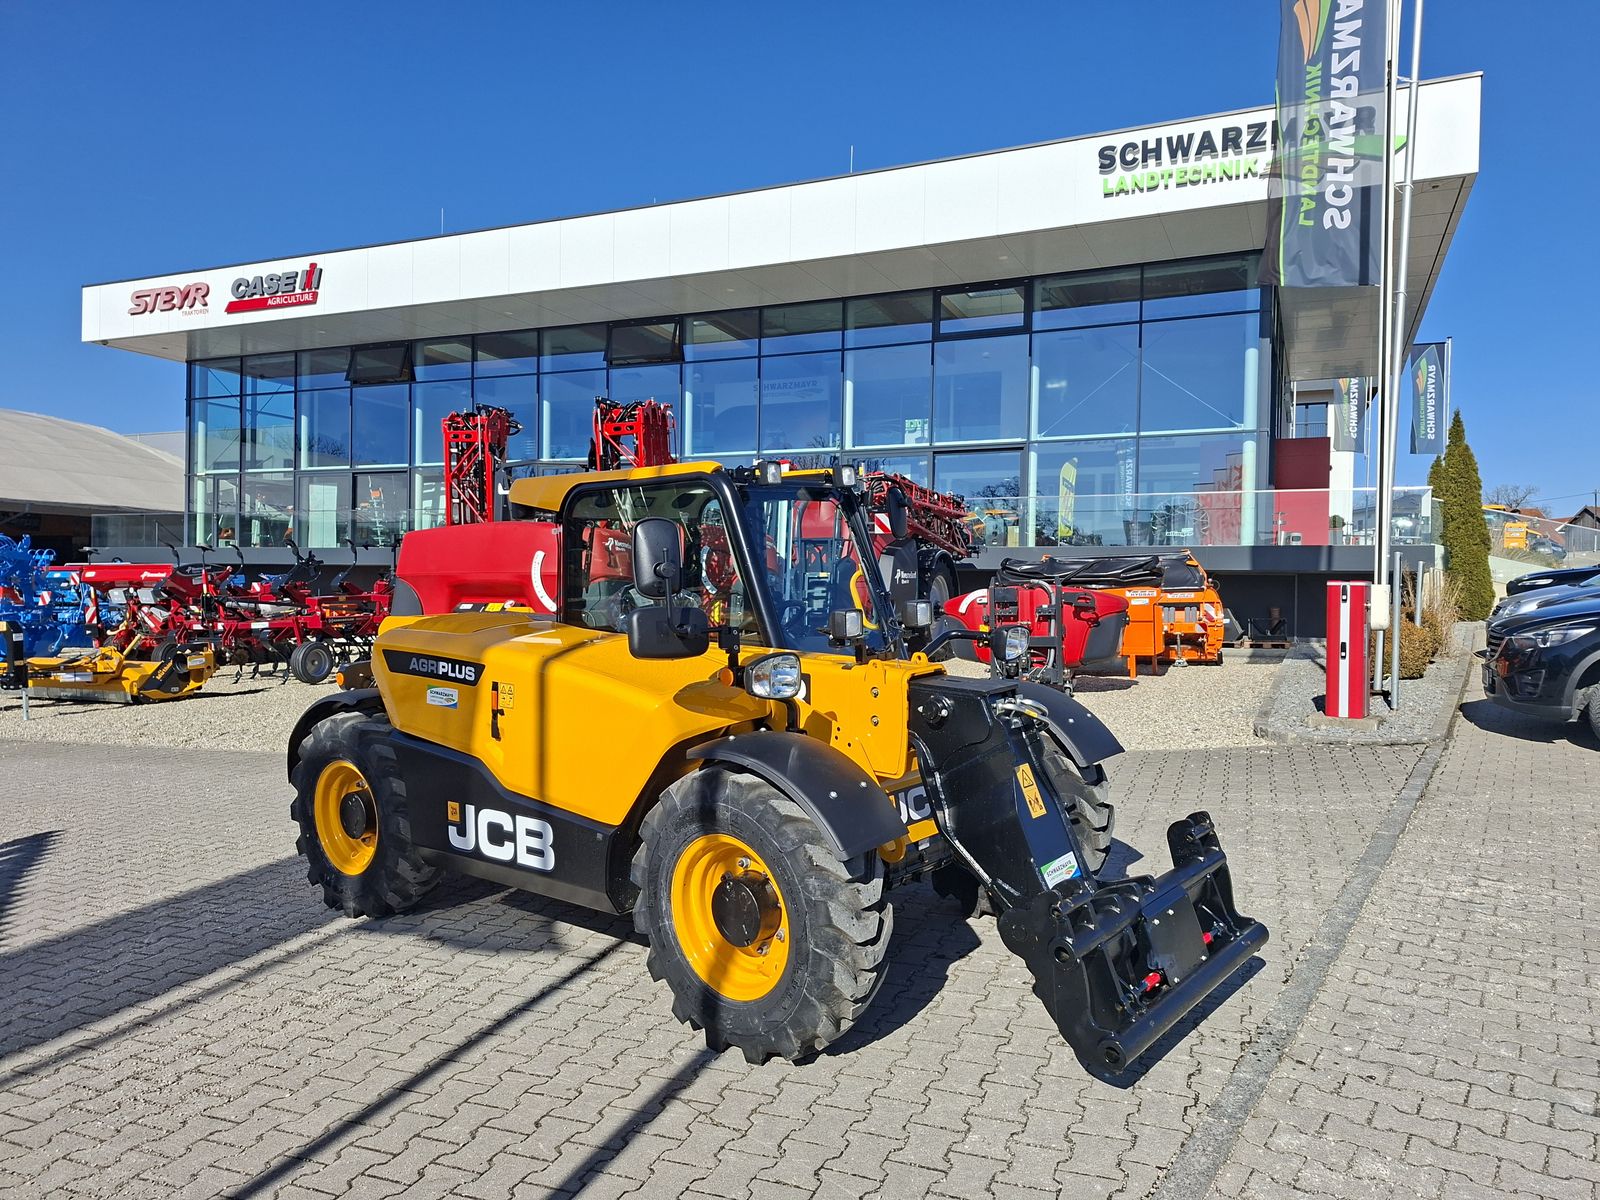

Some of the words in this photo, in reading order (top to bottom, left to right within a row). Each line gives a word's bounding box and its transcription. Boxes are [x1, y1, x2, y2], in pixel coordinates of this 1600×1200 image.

[1102, 157, 1259, 198] LANDTECHNIK
[128, 281, 210, 316] STEYR
[231, 271, 299, 300] CASE
[266, 291, 314, 307] AGRICULTURE
[181, 307, 210, 317] TRAKTOREN
[752, 379, 819, 393] SHWARZMAYR
[448, 803, 555, 871] JCB
